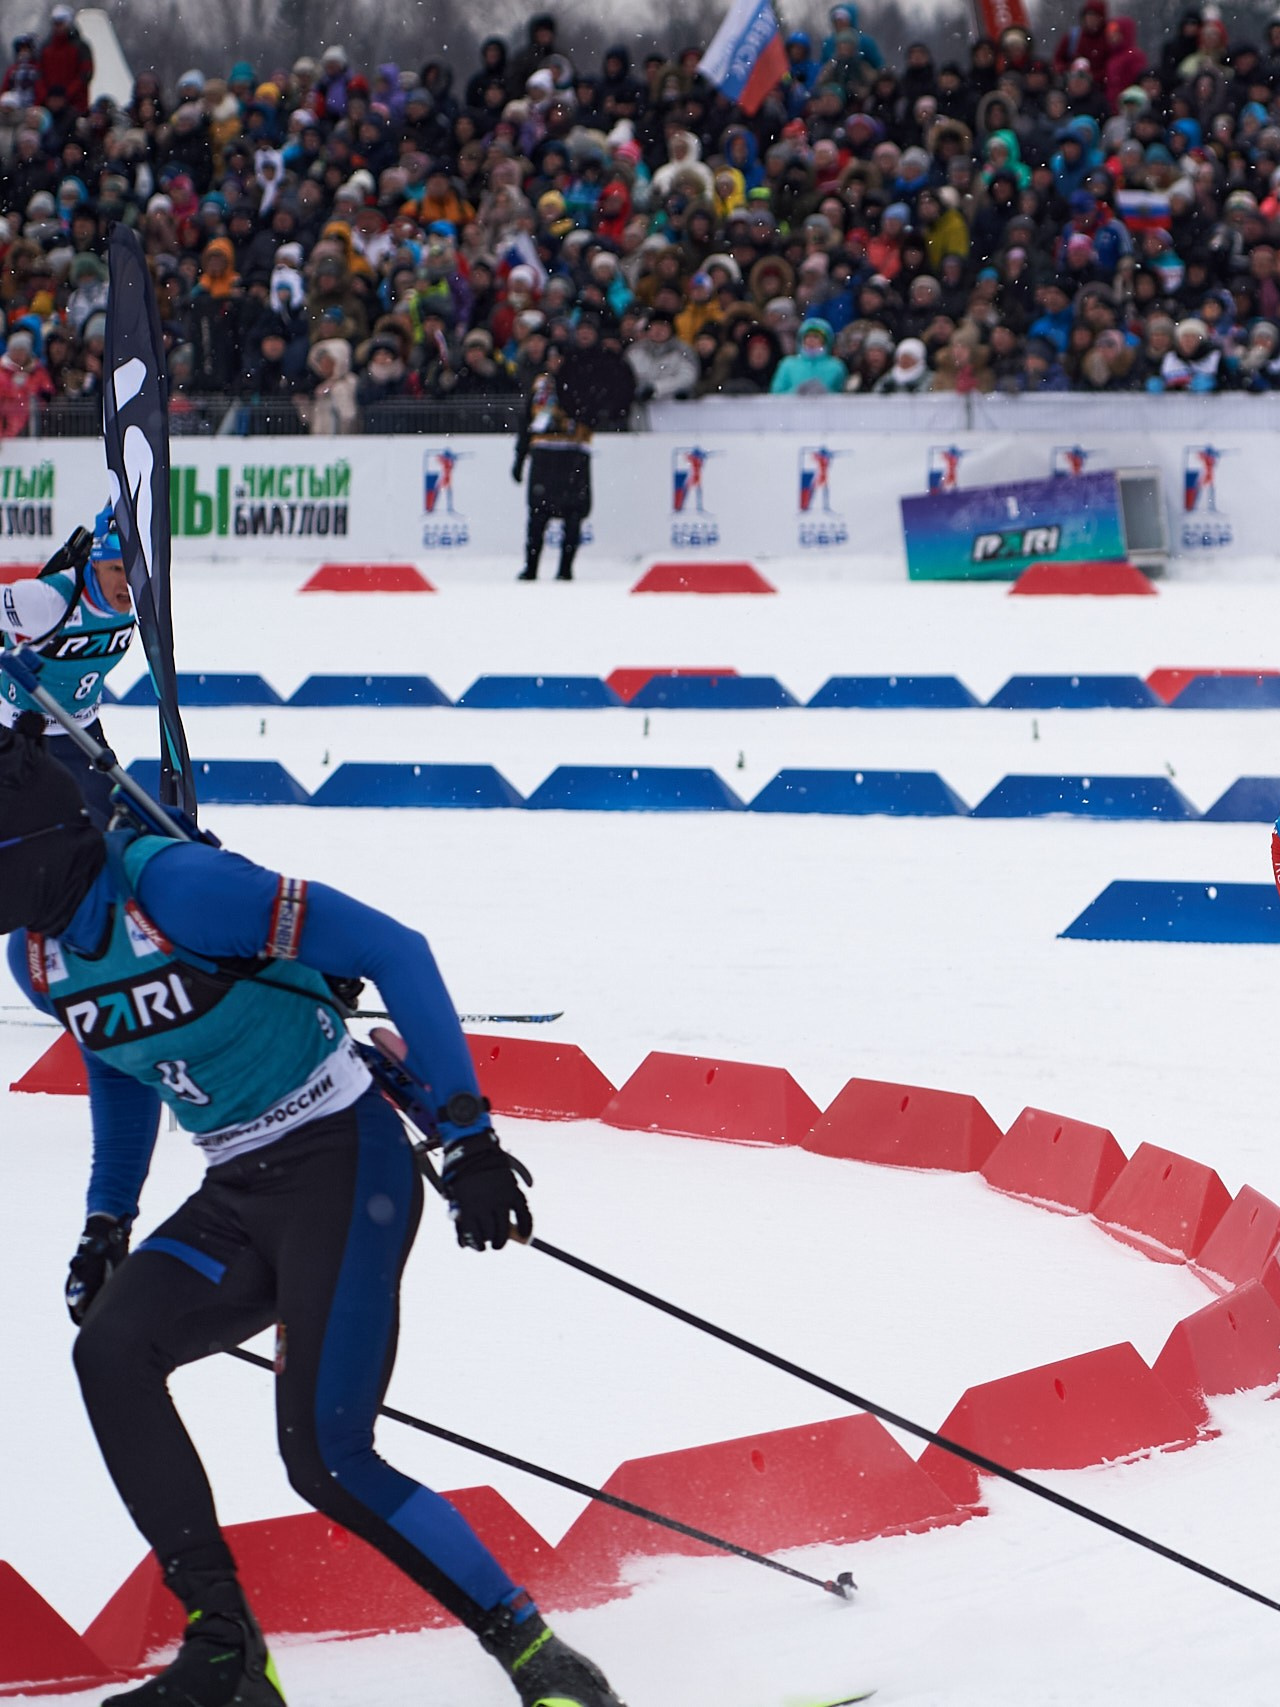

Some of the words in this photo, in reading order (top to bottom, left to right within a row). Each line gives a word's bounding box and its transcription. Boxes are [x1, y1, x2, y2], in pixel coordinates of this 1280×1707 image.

[242, 458, 352, 499] ЧИСТЫЙ
[0, 504, 54, 537] ЛОН
[234, 504, 348, 537] БИАТЛОН
[972, 526, 1060, 562] PARI
[56, 627, 135, 657] PAR
[74, 671, 101, 701] 8
[66, 974, 193, 1043] PARI
[263, 1074, 335, 1128] РОССИИ
